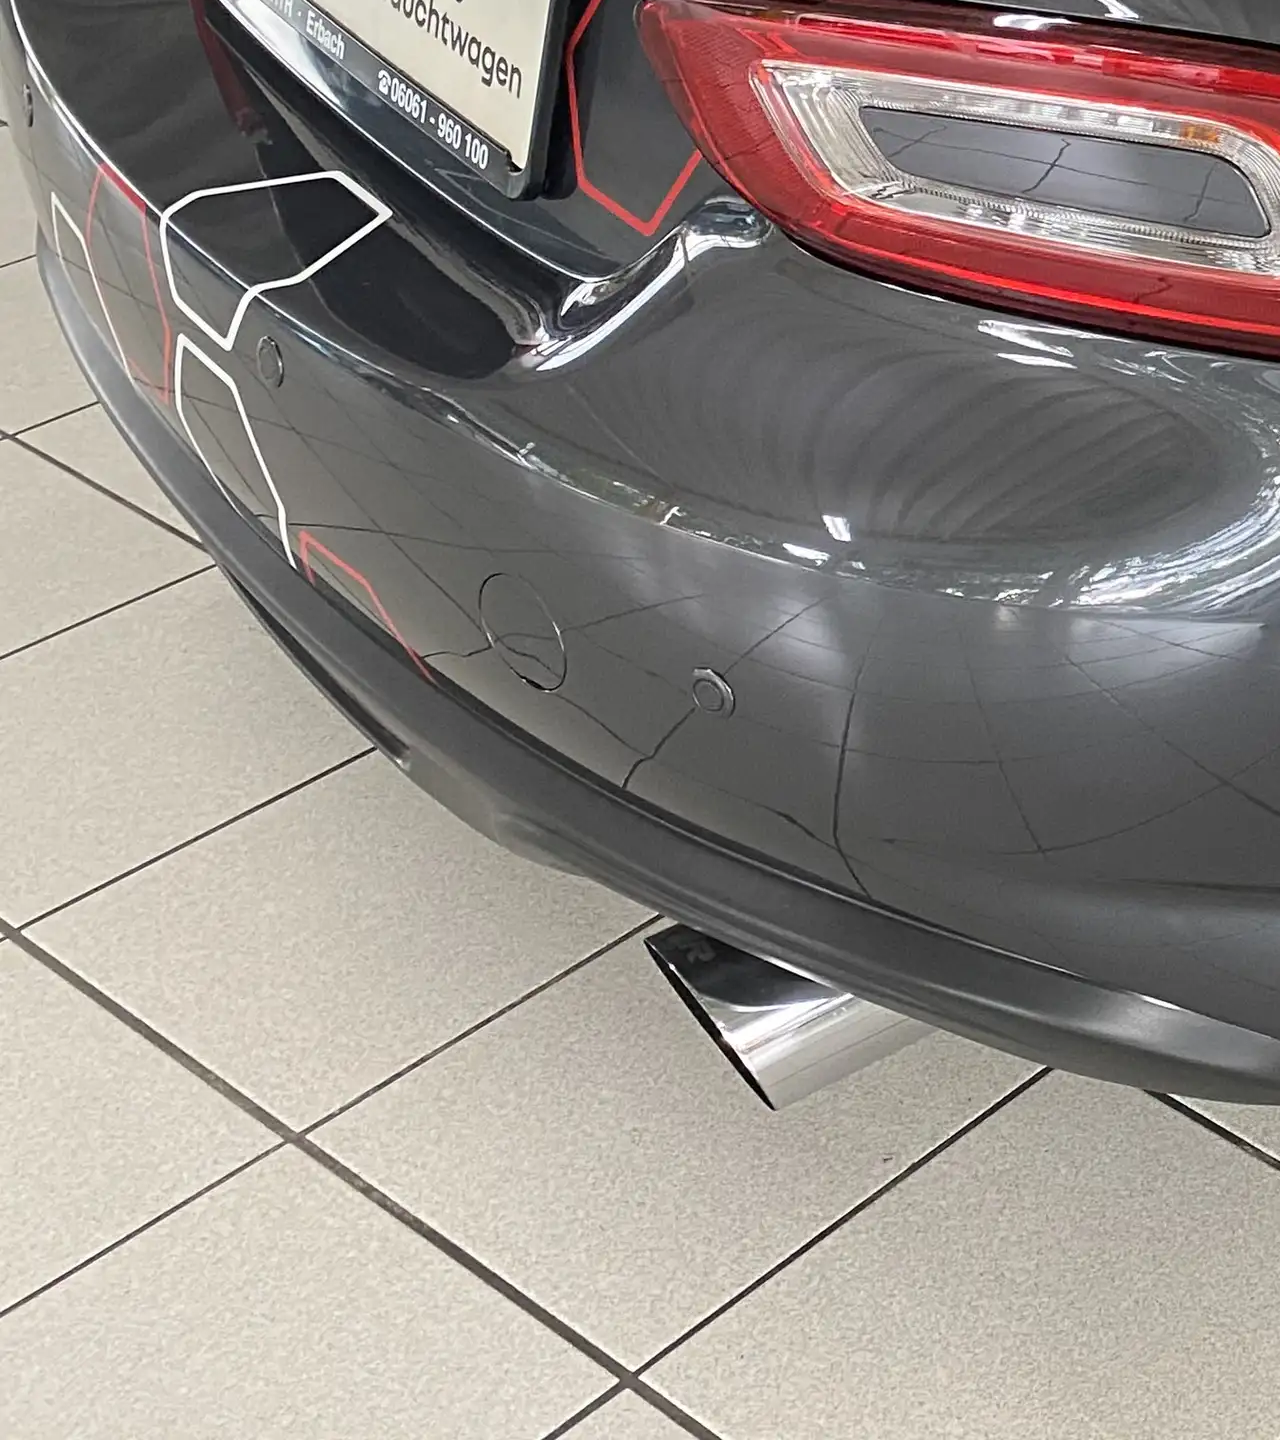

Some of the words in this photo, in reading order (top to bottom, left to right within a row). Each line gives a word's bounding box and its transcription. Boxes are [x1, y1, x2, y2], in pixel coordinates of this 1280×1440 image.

[306, 8, 346, 61] Erbach
[391, 80, 428, 125] 06061
[437, 113, 462, 151] 960
[464, 132, 489, 170] 100
